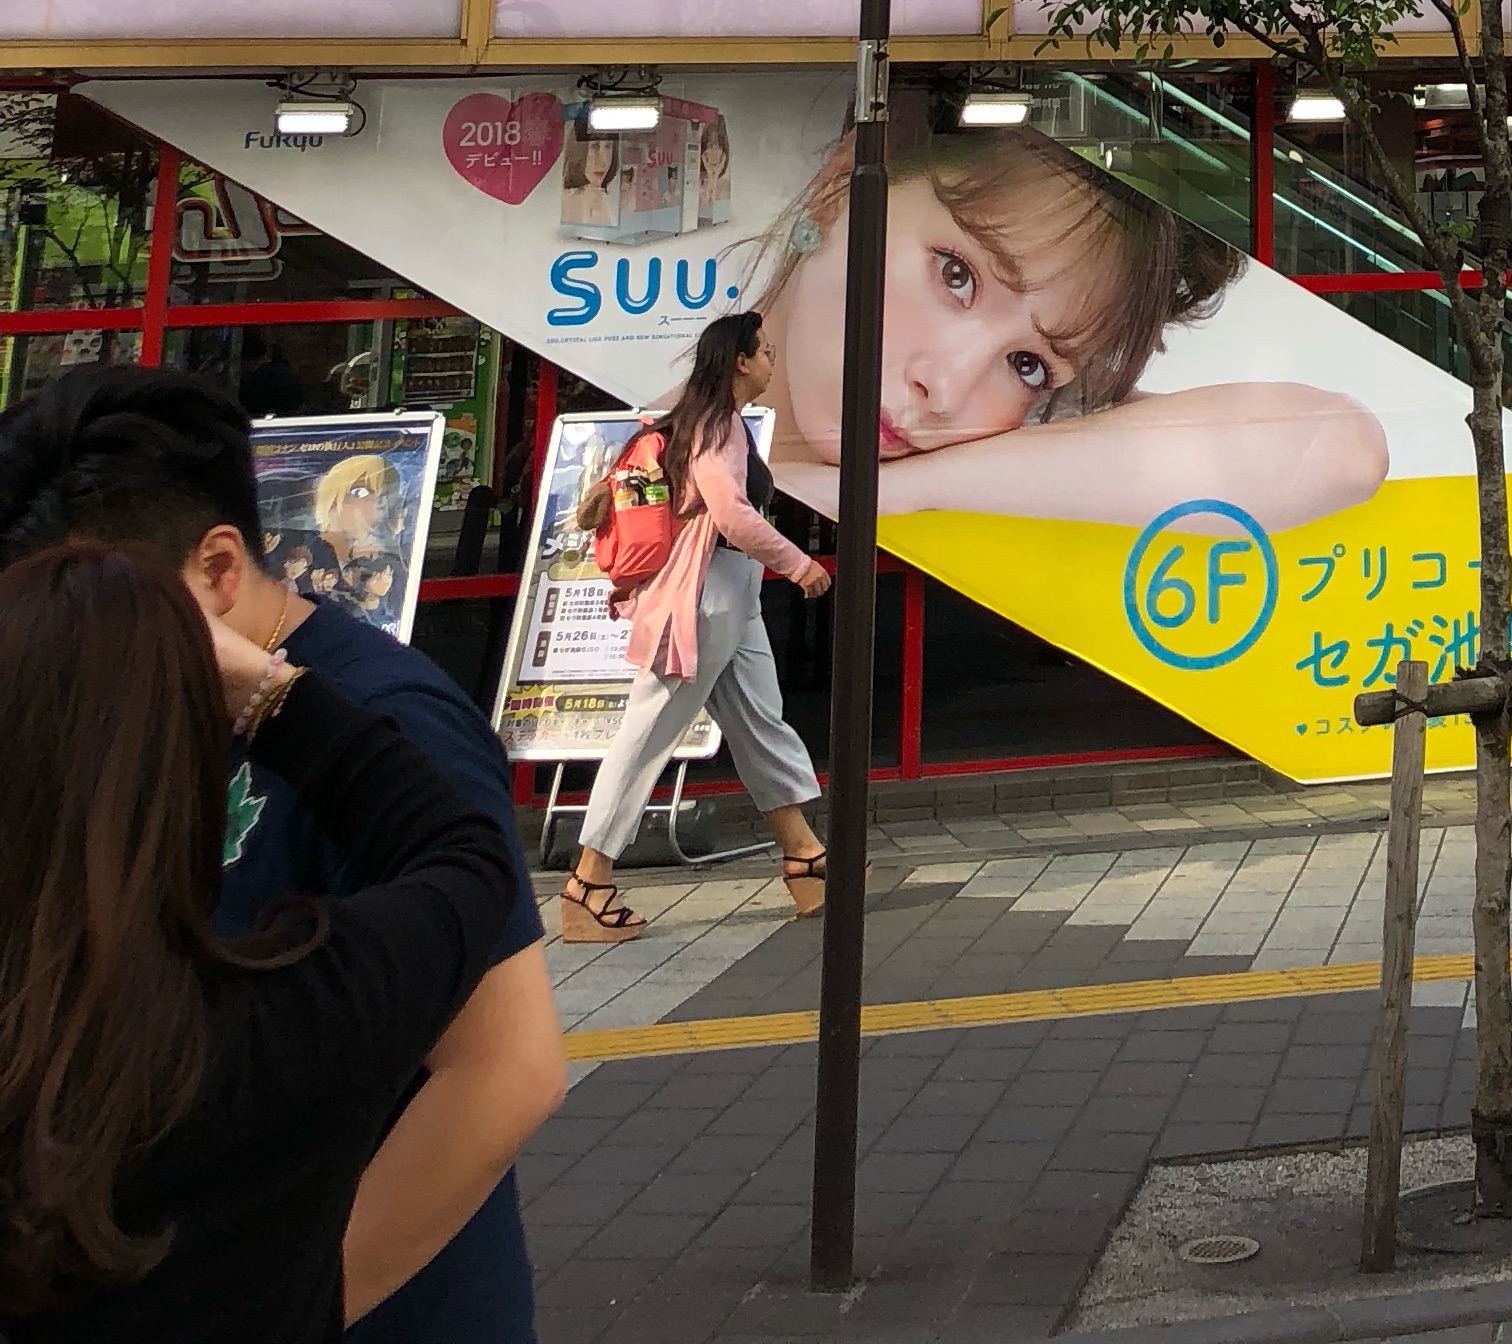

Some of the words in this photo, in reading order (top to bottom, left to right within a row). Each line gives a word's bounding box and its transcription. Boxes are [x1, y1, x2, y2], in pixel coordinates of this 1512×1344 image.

[466, 150, 542, 168] デビュー!!
[1145, 540, 1253, 630] 6F
